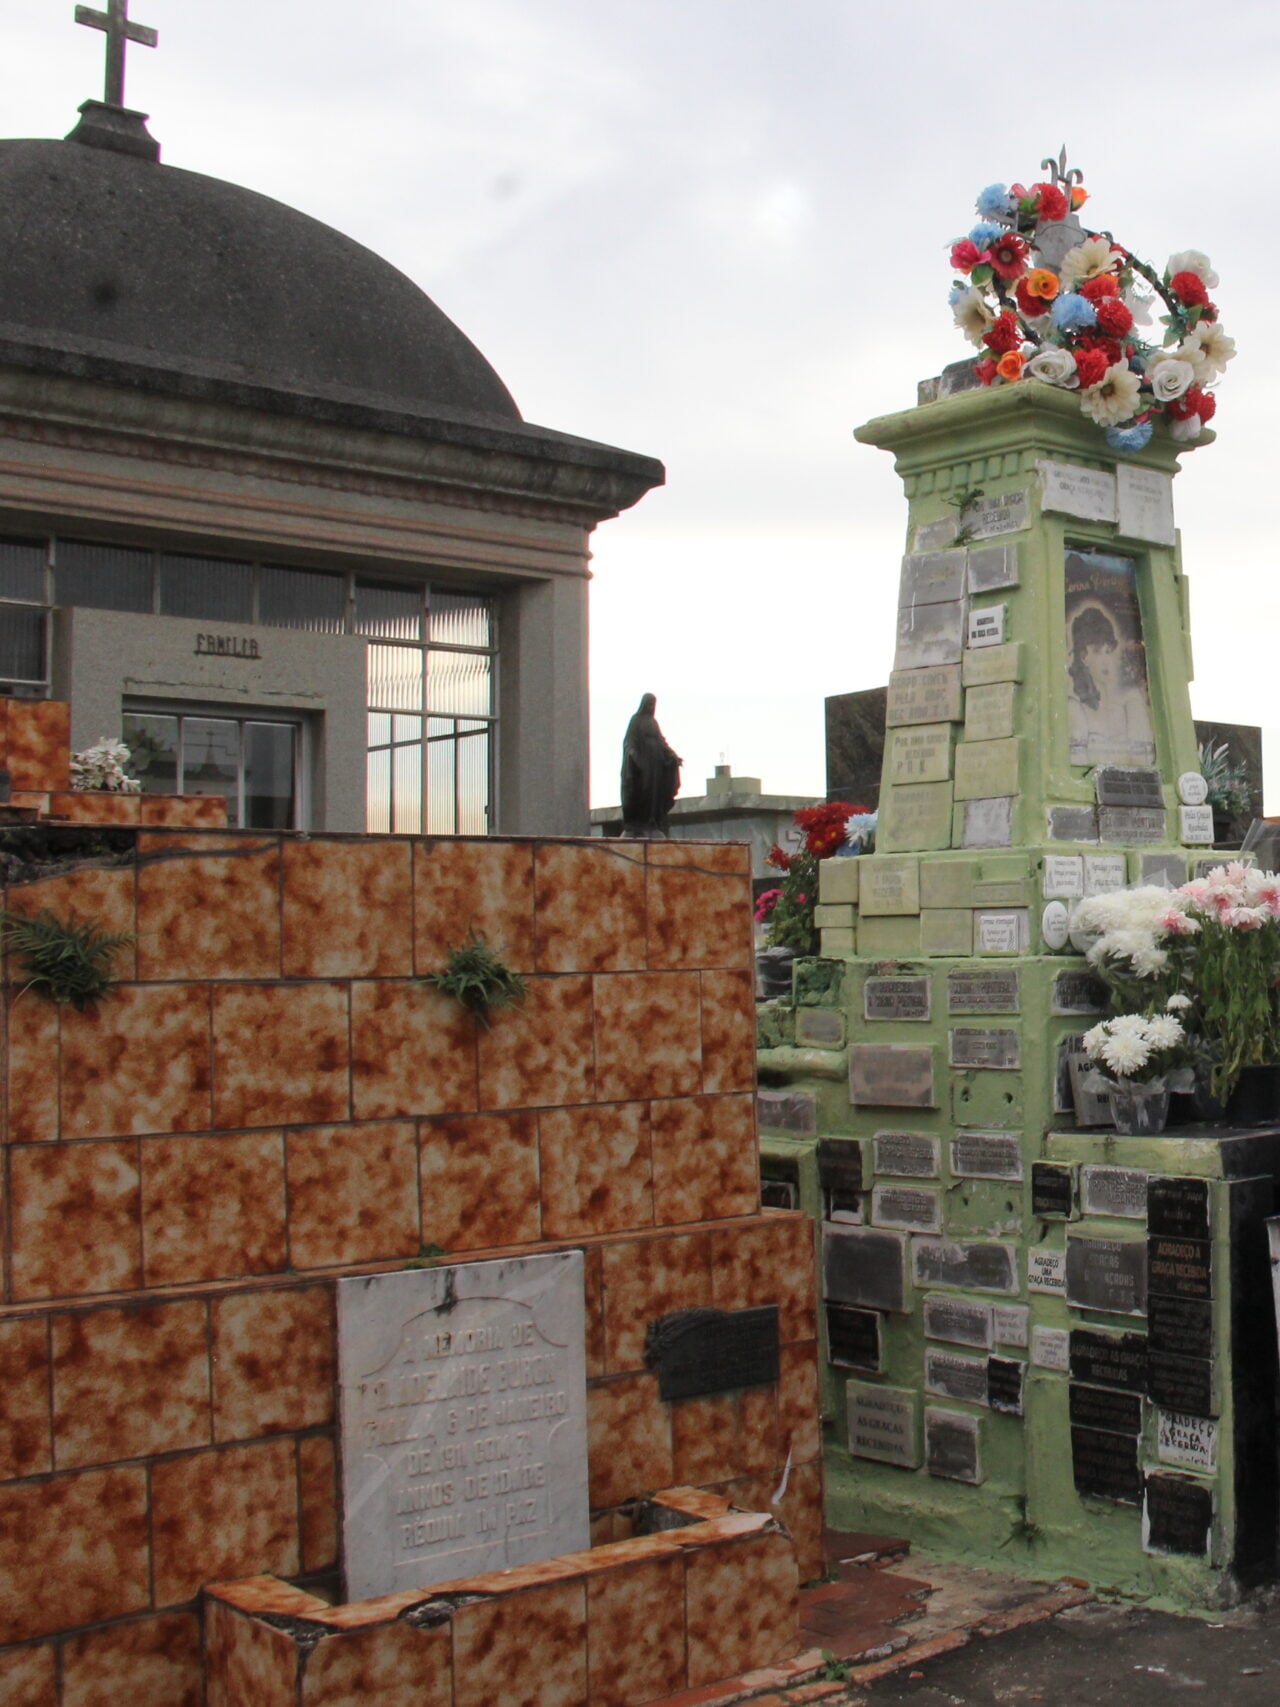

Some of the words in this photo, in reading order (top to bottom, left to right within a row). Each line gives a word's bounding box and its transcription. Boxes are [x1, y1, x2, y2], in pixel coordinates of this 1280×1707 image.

[1157, 1242, 1194, 1261] AGRADEÇO
[1195, 1246, 1201, 1259] A
[1034, 1256, 1059, 1268] AGRADEÇO
[1041, 1267, 1052, 1276] UMA
[1151, 1262, 1174, 1280] GRAÇA
[1175, 1264, 1207, 1281] RECEBIDA
[1028, 1274, 1043, 1287] GRAÇA
[1043, 1276, 1066, 1288] RECEBIDA
